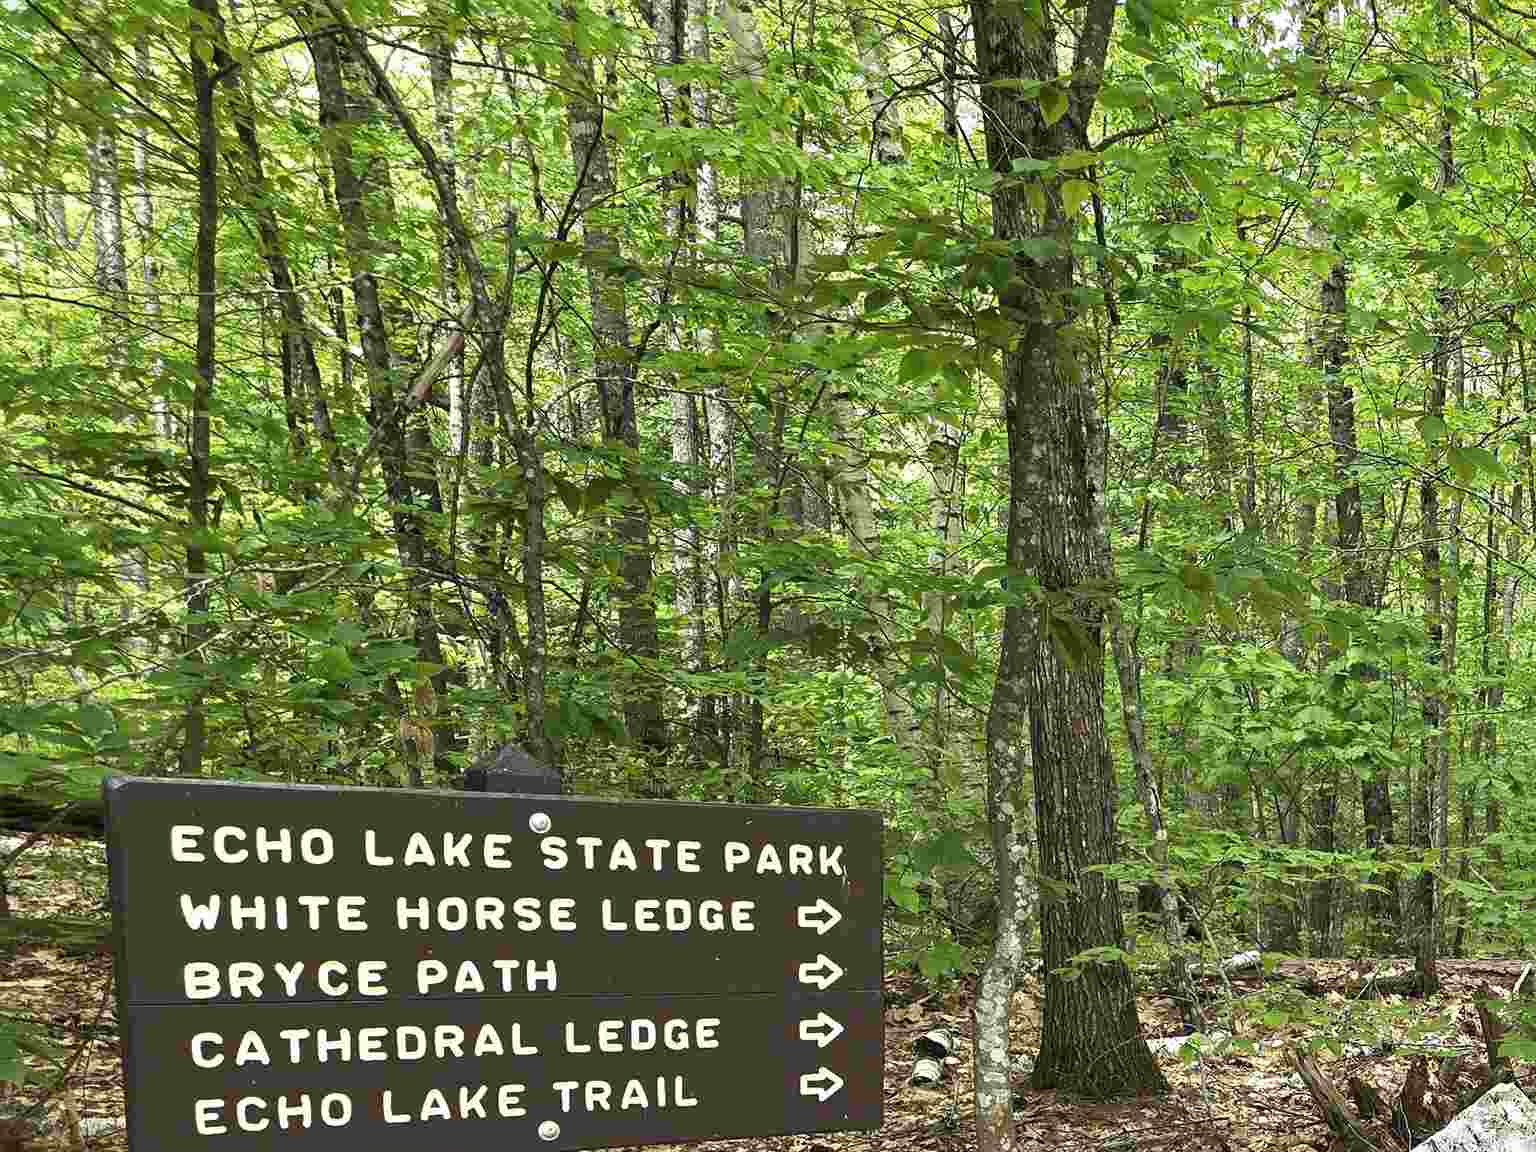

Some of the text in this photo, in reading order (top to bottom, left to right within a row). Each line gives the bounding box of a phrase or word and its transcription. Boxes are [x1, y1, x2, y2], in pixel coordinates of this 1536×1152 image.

[170, 825, 845, 876] ECHO LAKE STATE PARK
[180, 893, 755, 932] WHITE HORSE LEDGE
[183, 959, 557, 1000] BRYCE PATH
[191, 1017, 721, 1069] CATHEDRAL LEDGE
[195, 1075, 698, 1136] ECHO LAKE TRAIL
